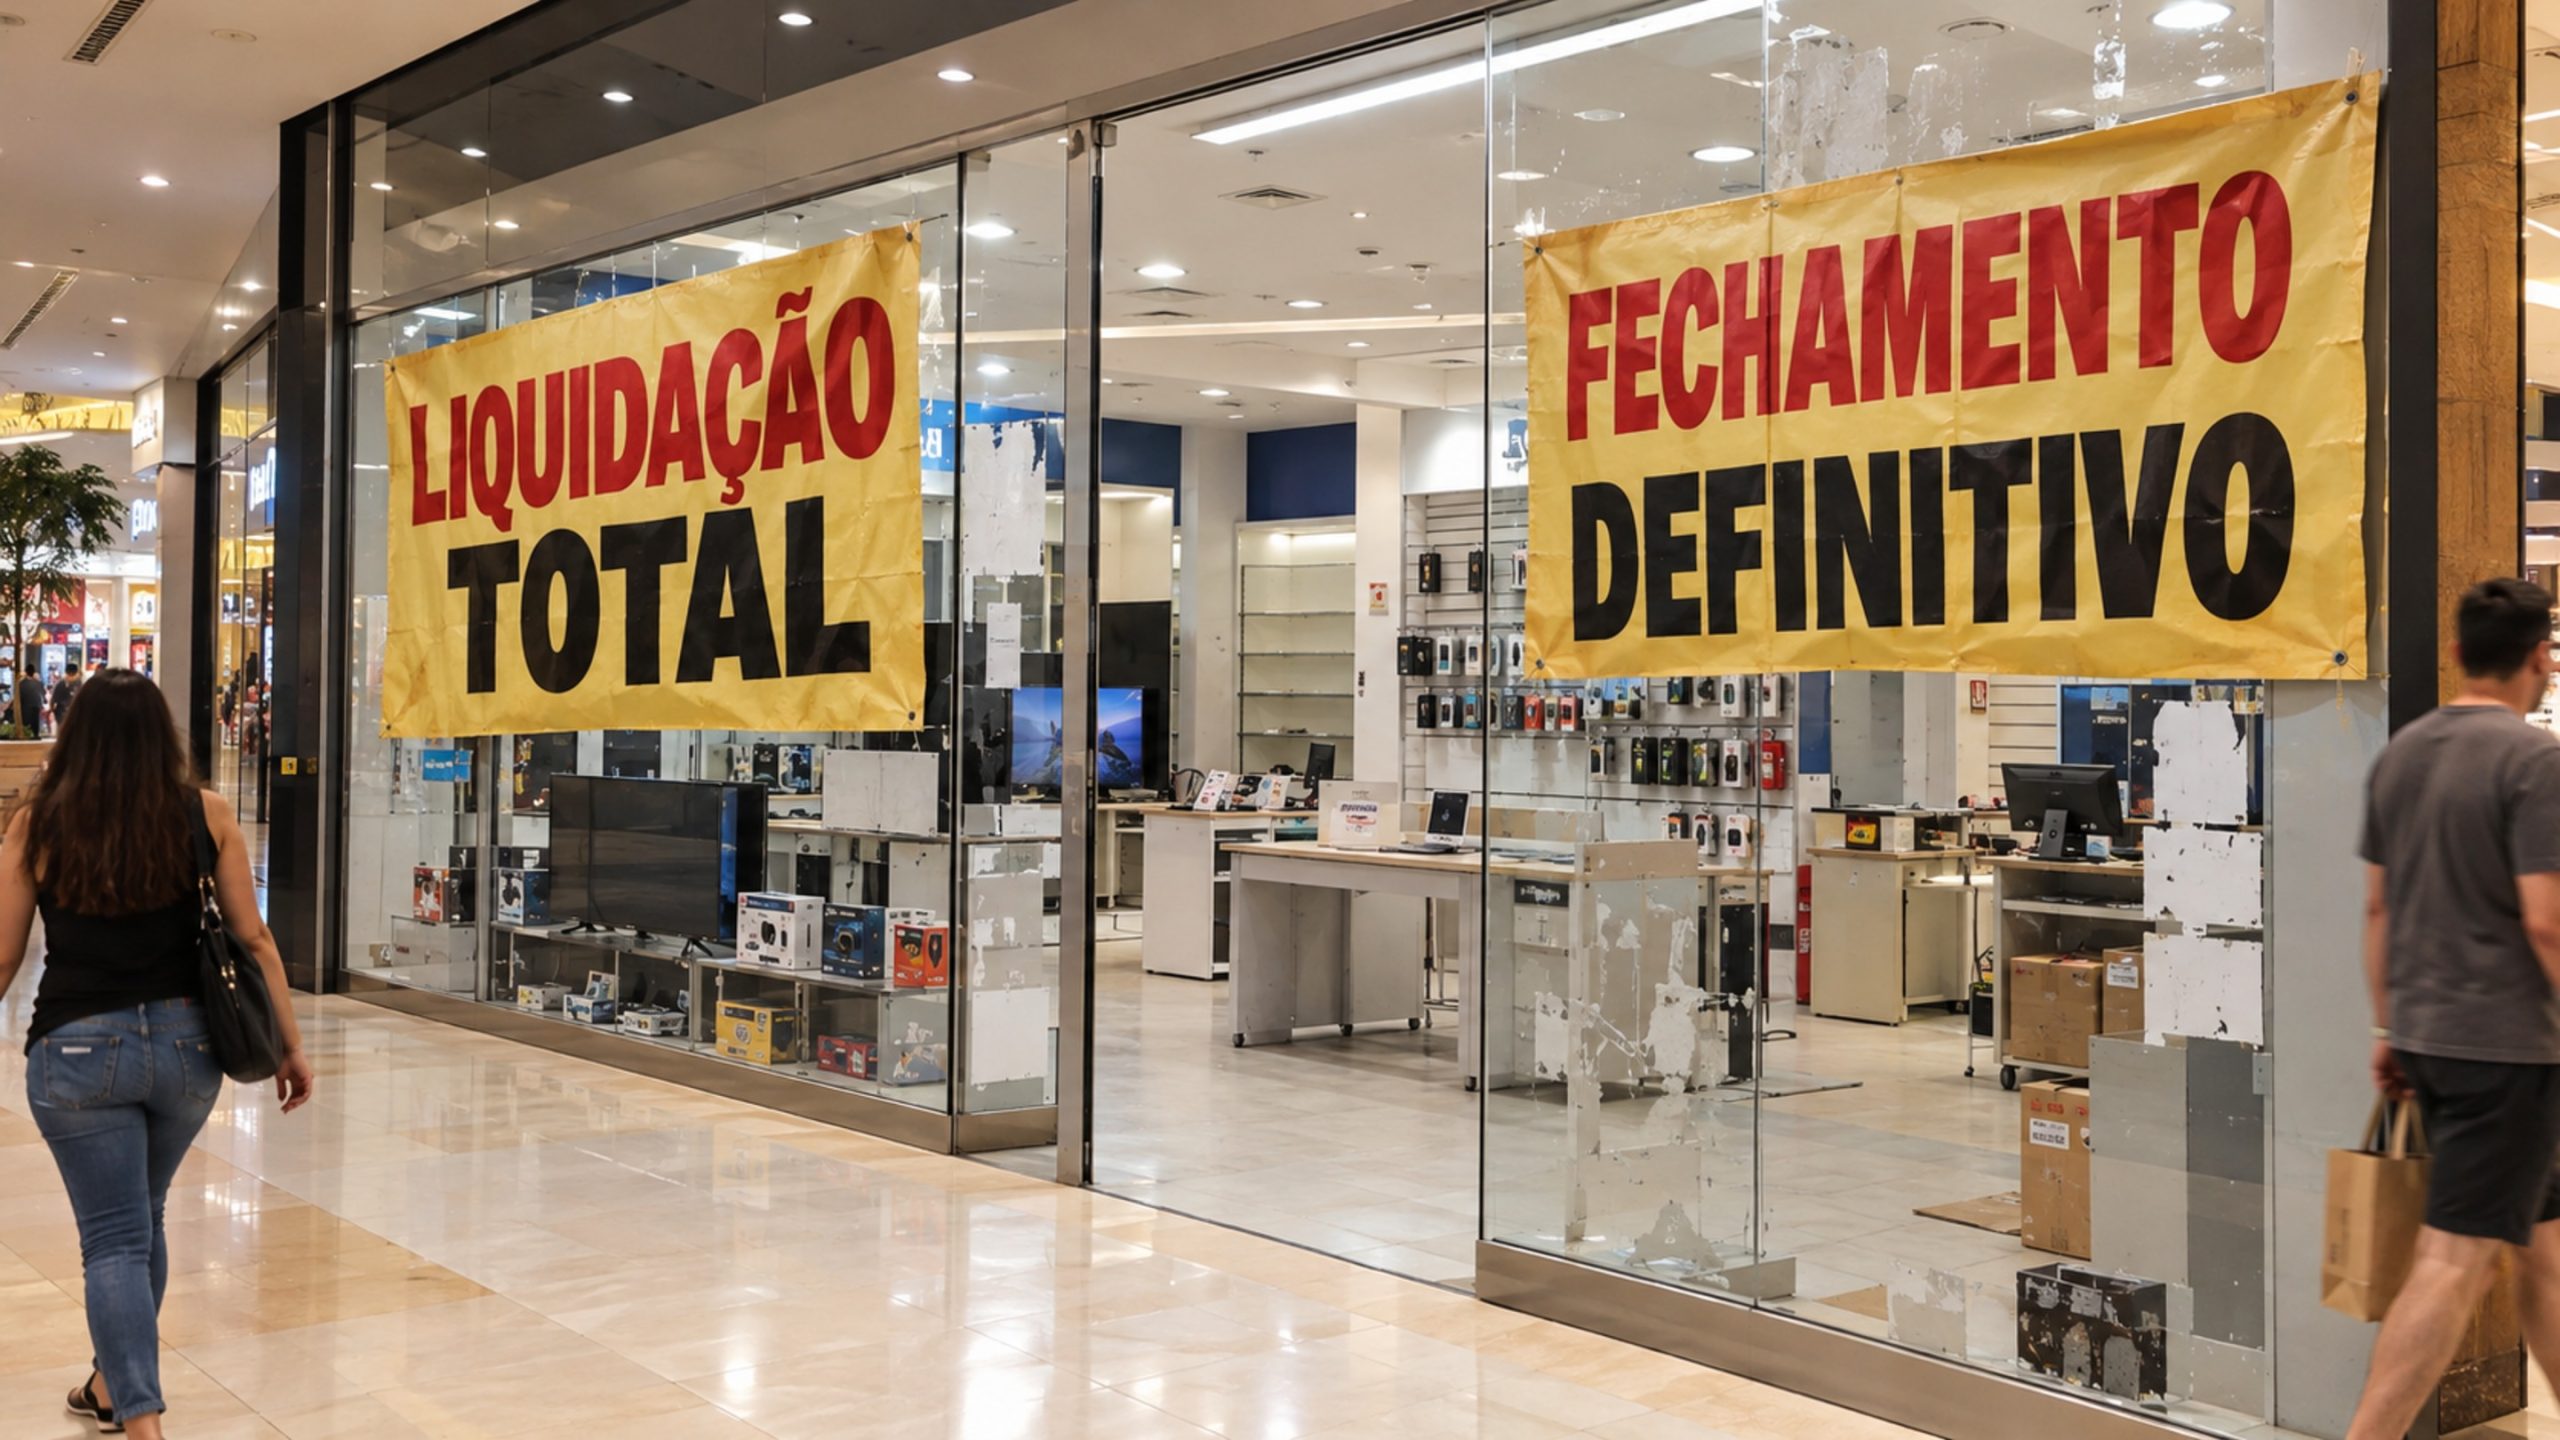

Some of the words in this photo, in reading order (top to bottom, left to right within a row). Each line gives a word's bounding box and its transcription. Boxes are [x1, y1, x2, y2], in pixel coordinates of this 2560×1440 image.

[410, 287, 895, 532] LIQUIDAÇÃO
[1567, 170, 2292, 441] FECHAMENTO
[448, 496, 871, 694] TOTAL
[1572, 412, 2295, 642] DEFINITIVO
